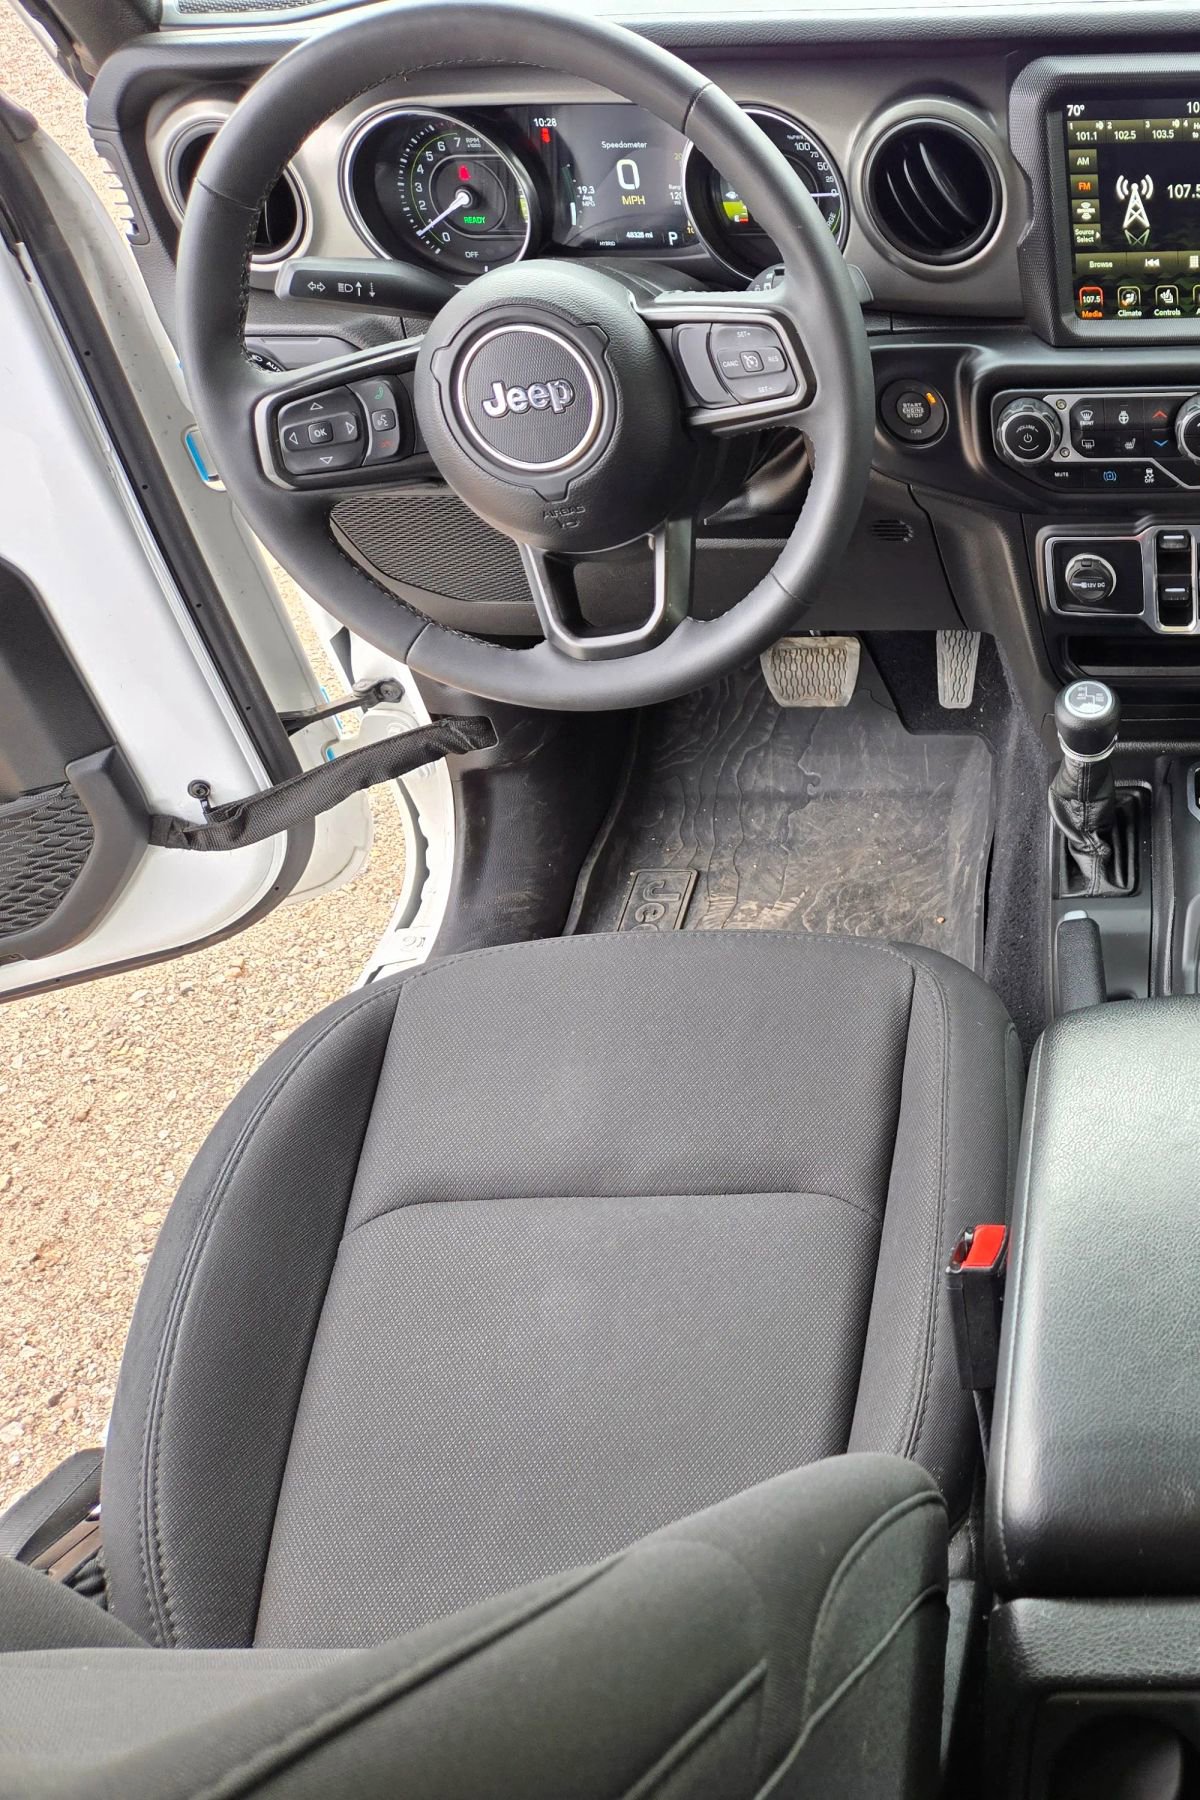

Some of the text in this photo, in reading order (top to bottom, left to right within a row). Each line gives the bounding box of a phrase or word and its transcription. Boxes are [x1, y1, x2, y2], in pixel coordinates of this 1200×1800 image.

[533, 118, 557, 127] 10:28
[1075, 131, 1098, 141] 101.1
[1114, 130, 1136, 140] 102.5
[1152, 129, 1175, 139] 103.5
[437, 141, 446, 151] 6
[454, 137, 461, 147] 7
[601, 141, 648, 149] Speedometer
[794, 142, 811, 151] 100
[426, 151, 434, 162] 5
[1077, 157, 1090, 166] AM
[416, 164, 425, 175] 4
[817, 162, 829, 171] 50
[616, 159, 641, 190] 0
[415, 182, 423, 192] 3
[577, 186, 595, 195] 19.3
[1078, 182, 1091, 191] FM
[419, 200, 428, 211] 2
[621, 195, 646, 206] MPH
[464, 216, 486, 224] READY
[441, 231, 451, 242] 0
[668, 232, 678, 246] P
[465, 251, 479, 259] OFF
[1089, 261, 1113, 269] Browse
[1082, 295, 1101, 304] 107.5
[1082, 310, 1102, 318] Media
[1117, 309, 1142, 317] Climate
[1154, 308, 1180, 316] Controls
[266, 361, 281, 373] AUT
[482, 379, 575, 418] Jeep
[313, 428, 328, 438] OK
